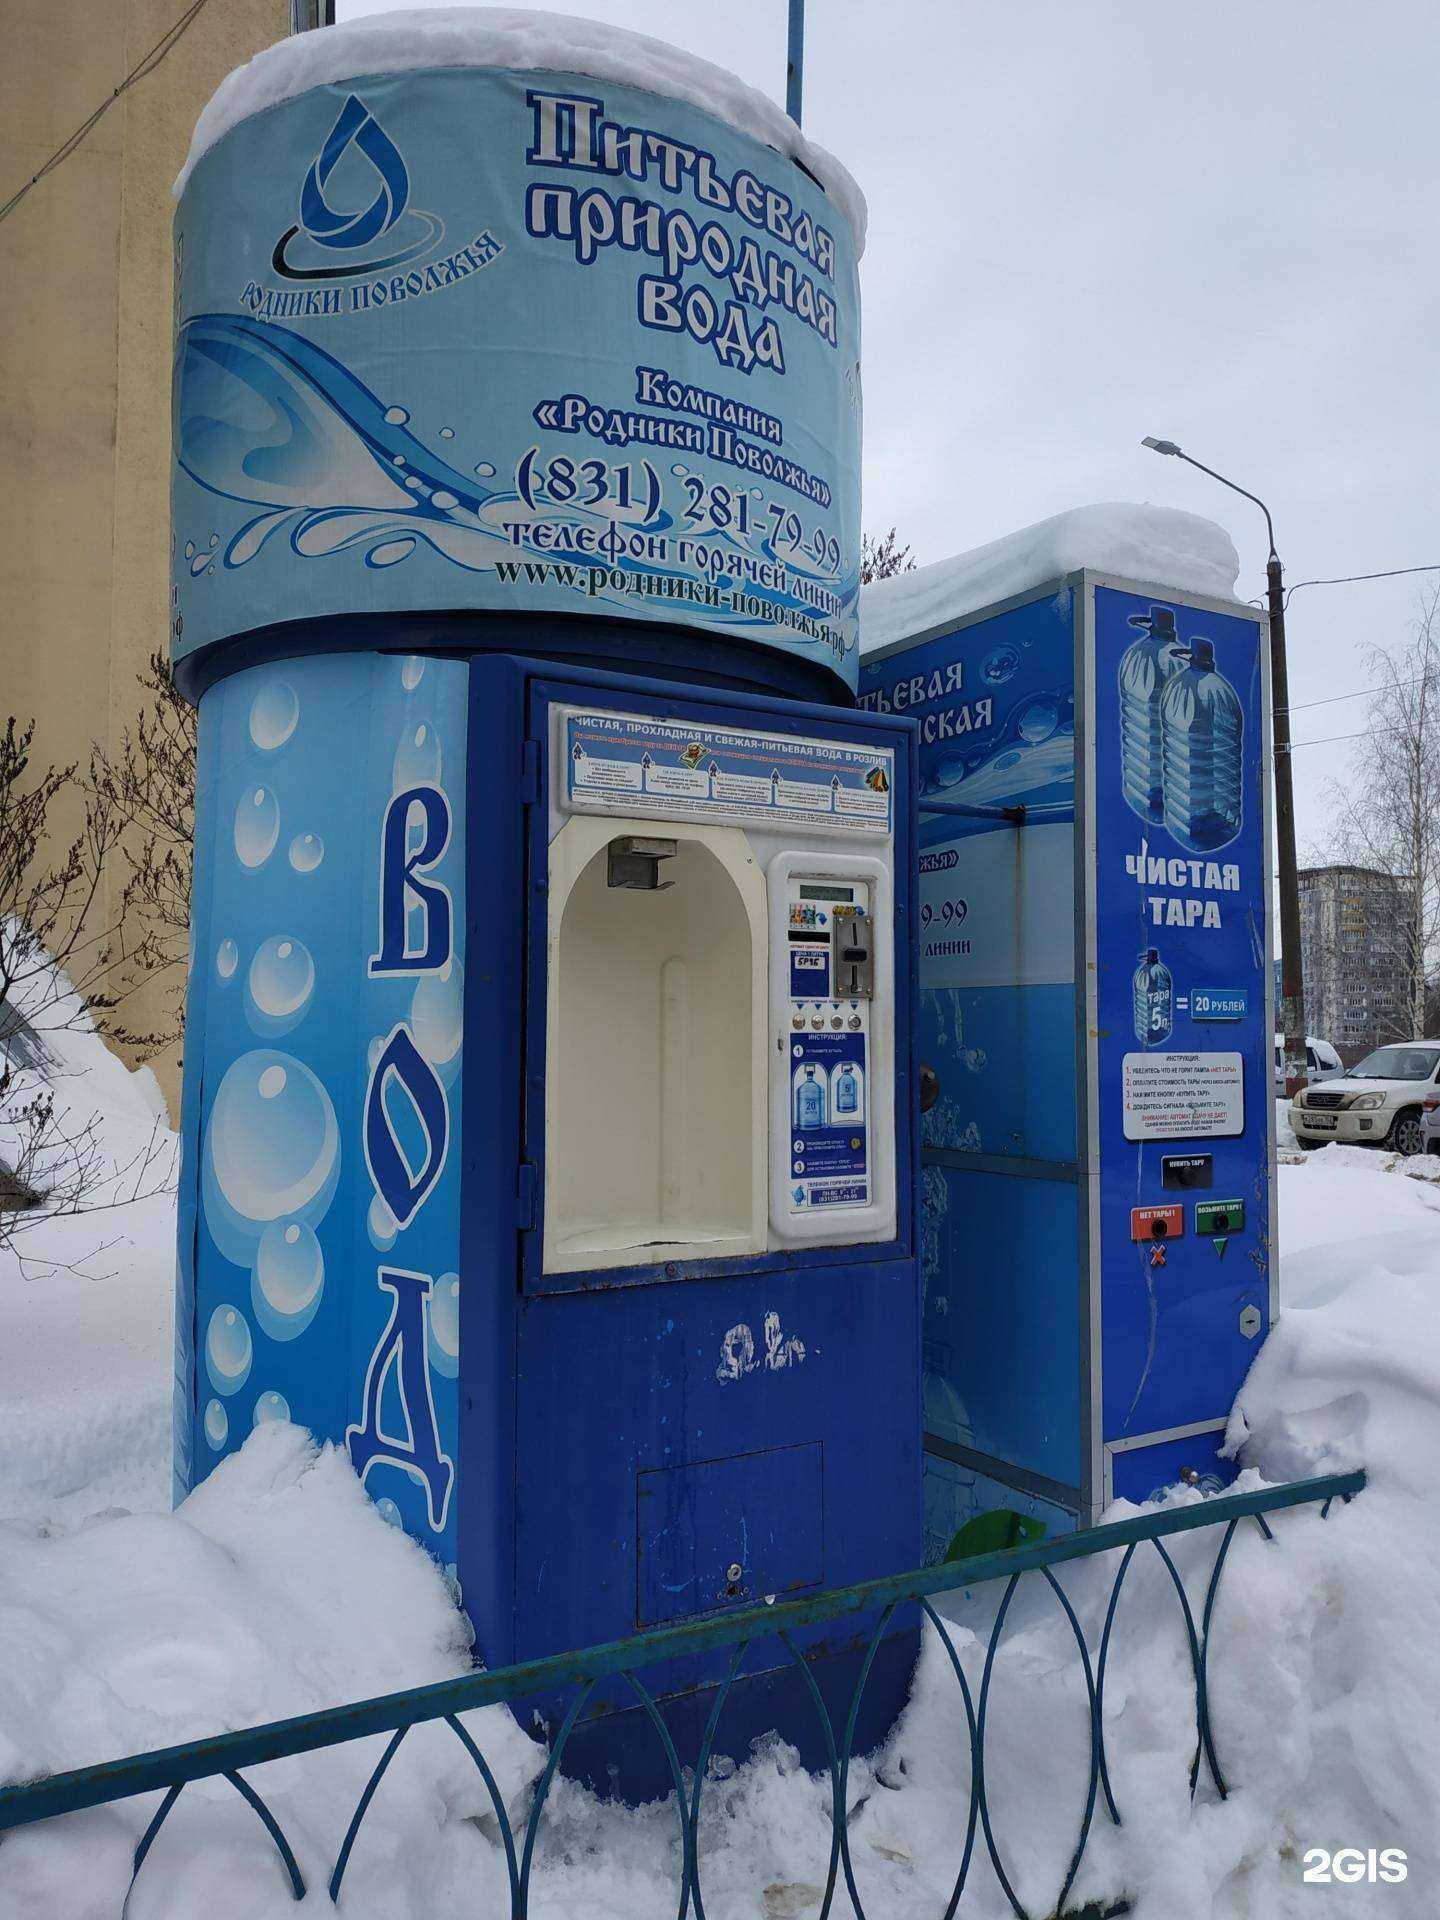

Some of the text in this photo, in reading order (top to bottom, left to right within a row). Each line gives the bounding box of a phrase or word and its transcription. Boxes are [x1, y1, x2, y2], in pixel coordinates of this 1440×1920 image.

[240, 230, 504, 321] РОДНИКИ ПОВОЛЖЬЯ
[526, 183, 838, 348] природная
[638, 274, 786, 375] вода
[636, 366, 783, 446] Компания
[532, 394, 832, 508] «Родники Поволжья»
[515, 447, 842, 574] (831) 281-79-99
[575, 718, 623, 733] ЧИСТАЯ,
[627, 723, 701, 741] ПРОХЛАДНАЯ
[704, 733, 712, 742] И
[715, 735, 813, 755] СВЕЖАЯ-ПИТЬЕВАЯ
[816, 748, 843, 760] ВОДА
[853, 754, 887, 765] РОЗЛИВ
[1125, 840, 1240, 892] ЧИСТАЯ
[1148, 897, 1221, 929] ТАРА
[1148, 989, 1170, 1004] тара
[1195, 996, 1245, 1012] 20 РУБЛЕЙ
[806, 1101, 816, 1111] 20
[1139, 1211, 1152, 1219] НЕТ
